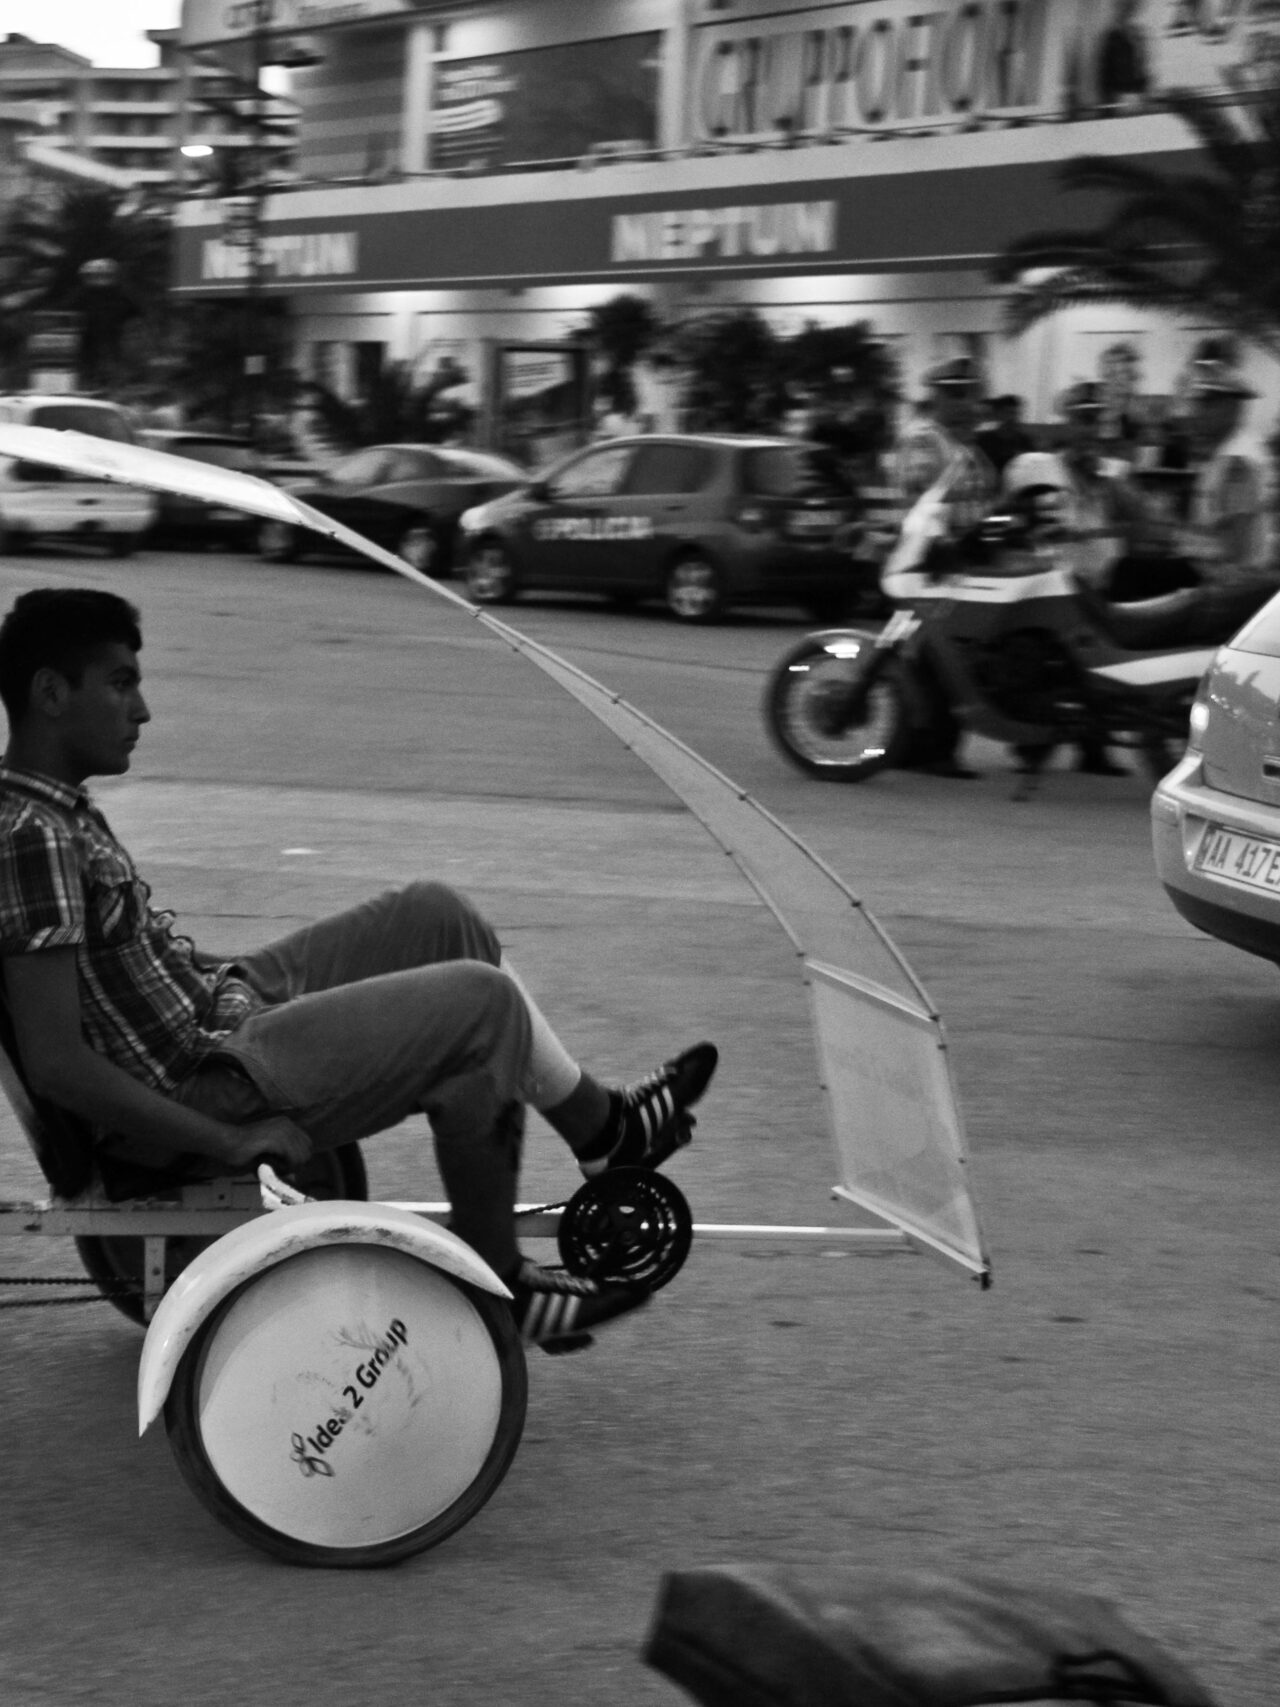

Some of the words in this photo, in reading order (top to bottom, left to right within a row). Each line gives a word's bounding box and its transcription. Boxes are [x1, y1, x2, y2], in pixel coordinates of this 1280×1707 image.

[611, 200, 838, 262] NEPTUN
[1234, 842, 1280, 886] 417E
[342, 1385, 364, 1409] 2
[356, 1318, 408, 1389] Group
